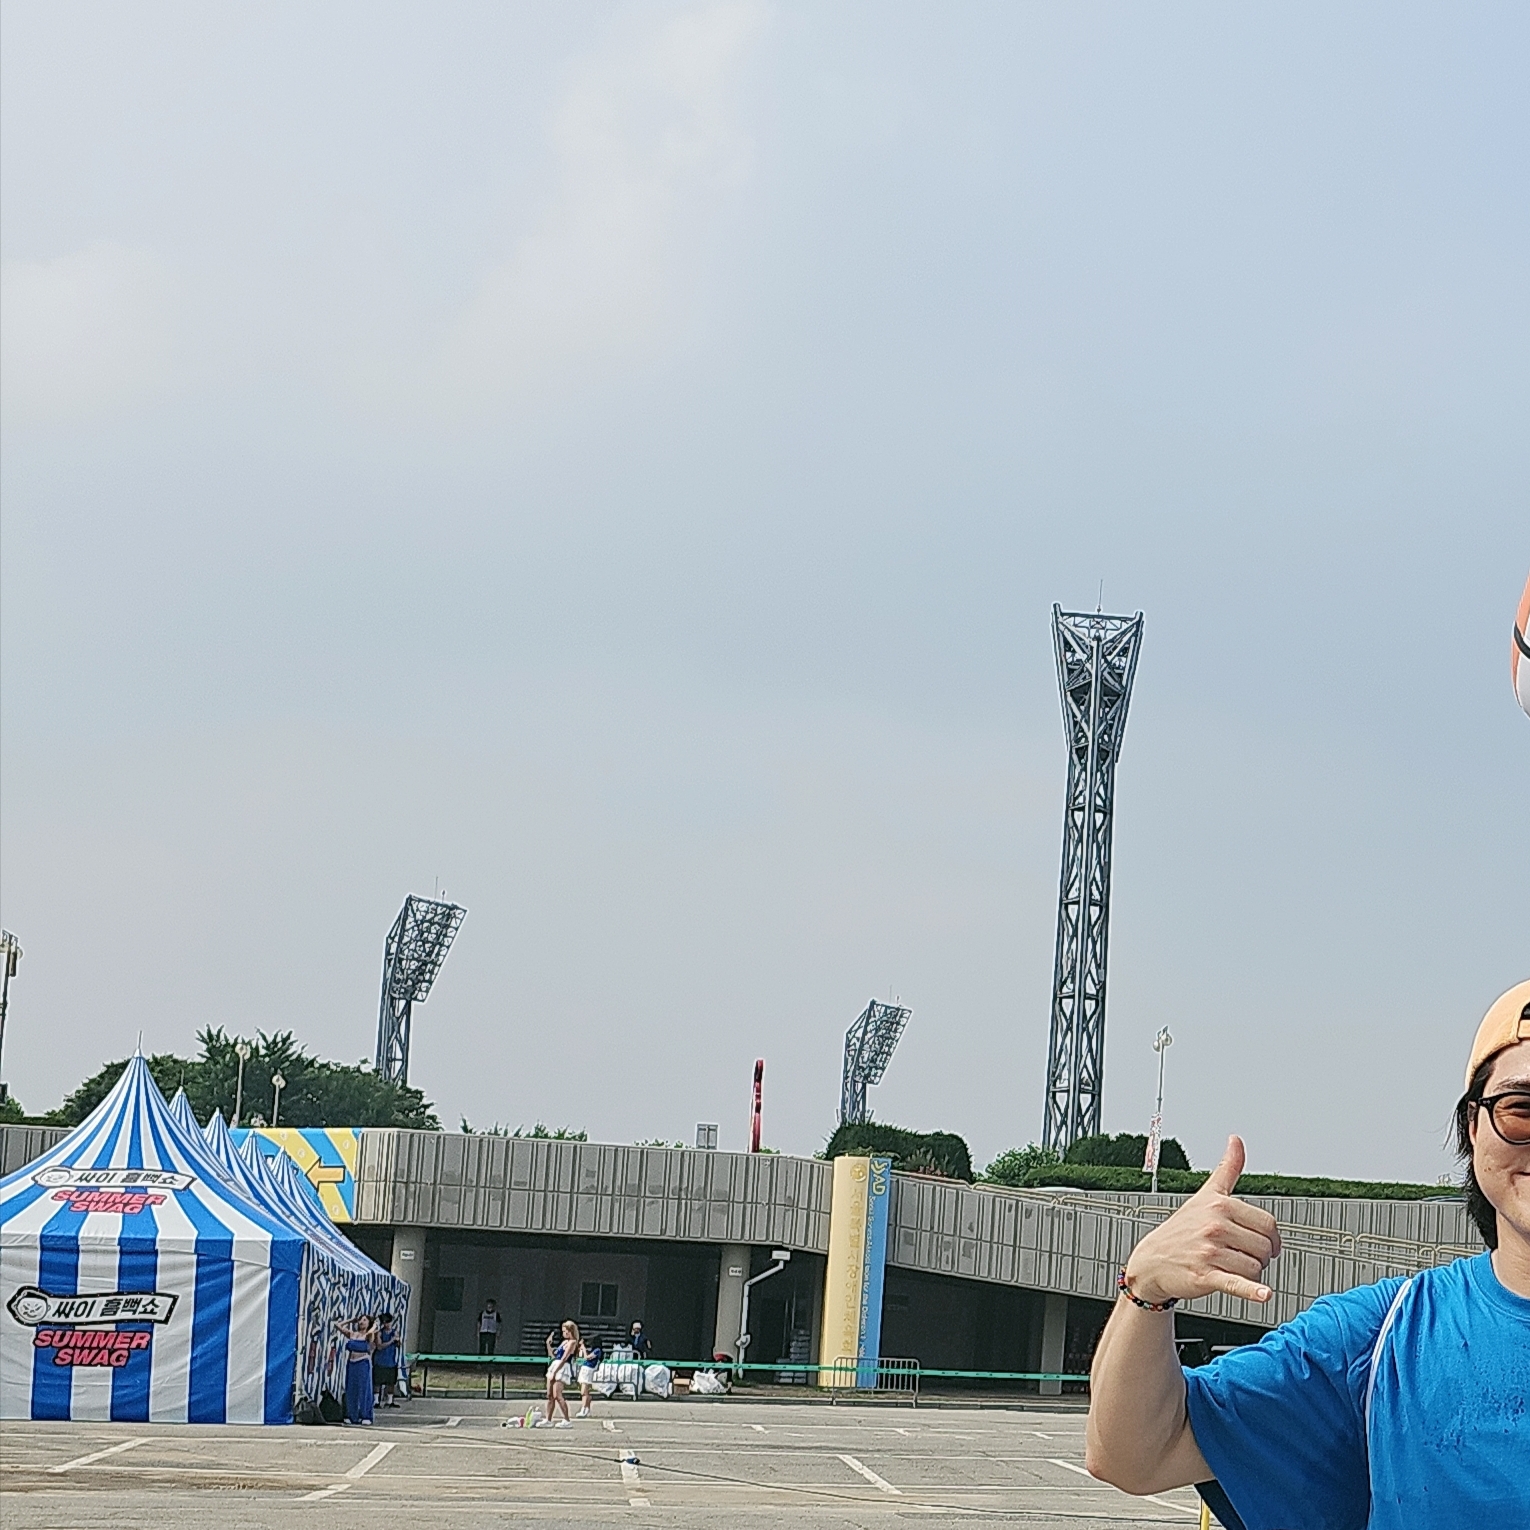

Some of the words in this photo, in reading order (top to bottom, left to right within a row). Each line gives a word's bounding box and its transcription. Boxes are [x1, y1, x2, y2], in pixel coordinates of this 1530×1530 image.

[74, 1172, 116, 1183] 싸이
[51, 1190, 168, 1205] SUMMER
[69, 1202, 144, 1214] SWAG
[52, 1300, 96, 1318] 싸이
[100, 1297, 160, 1317] 흠뻑쇼
[34, 1330, 151, 1349] SUMMER
[54, 1348, 130, 1366] SWAG
